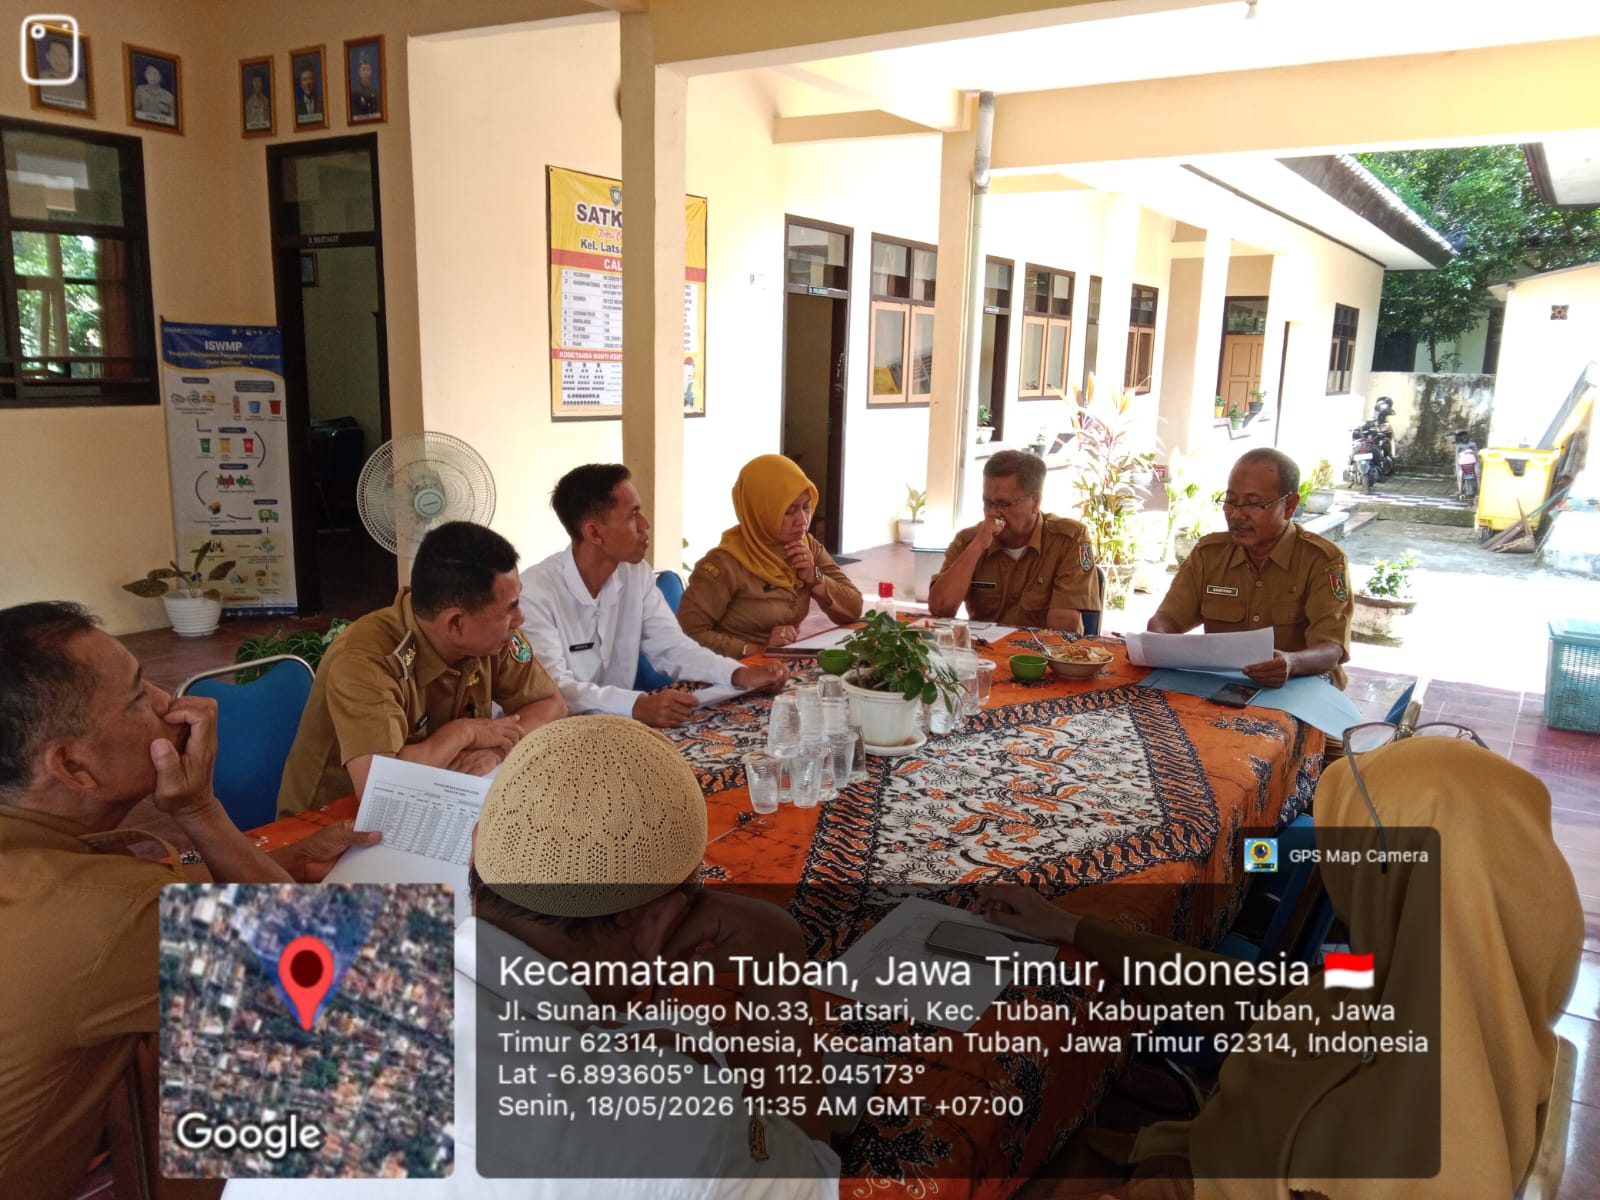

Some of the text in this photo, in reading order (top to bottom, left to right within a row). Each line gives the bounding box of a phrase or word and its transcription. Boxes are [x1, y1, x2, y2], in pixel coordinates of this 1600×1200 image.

[576, 203, 622, 228] SATK
[580, 238, 623, 254] Kel. Lats
[603, 258, 622, 271] CAL
[204, 340, 243, 351] ISWMP
